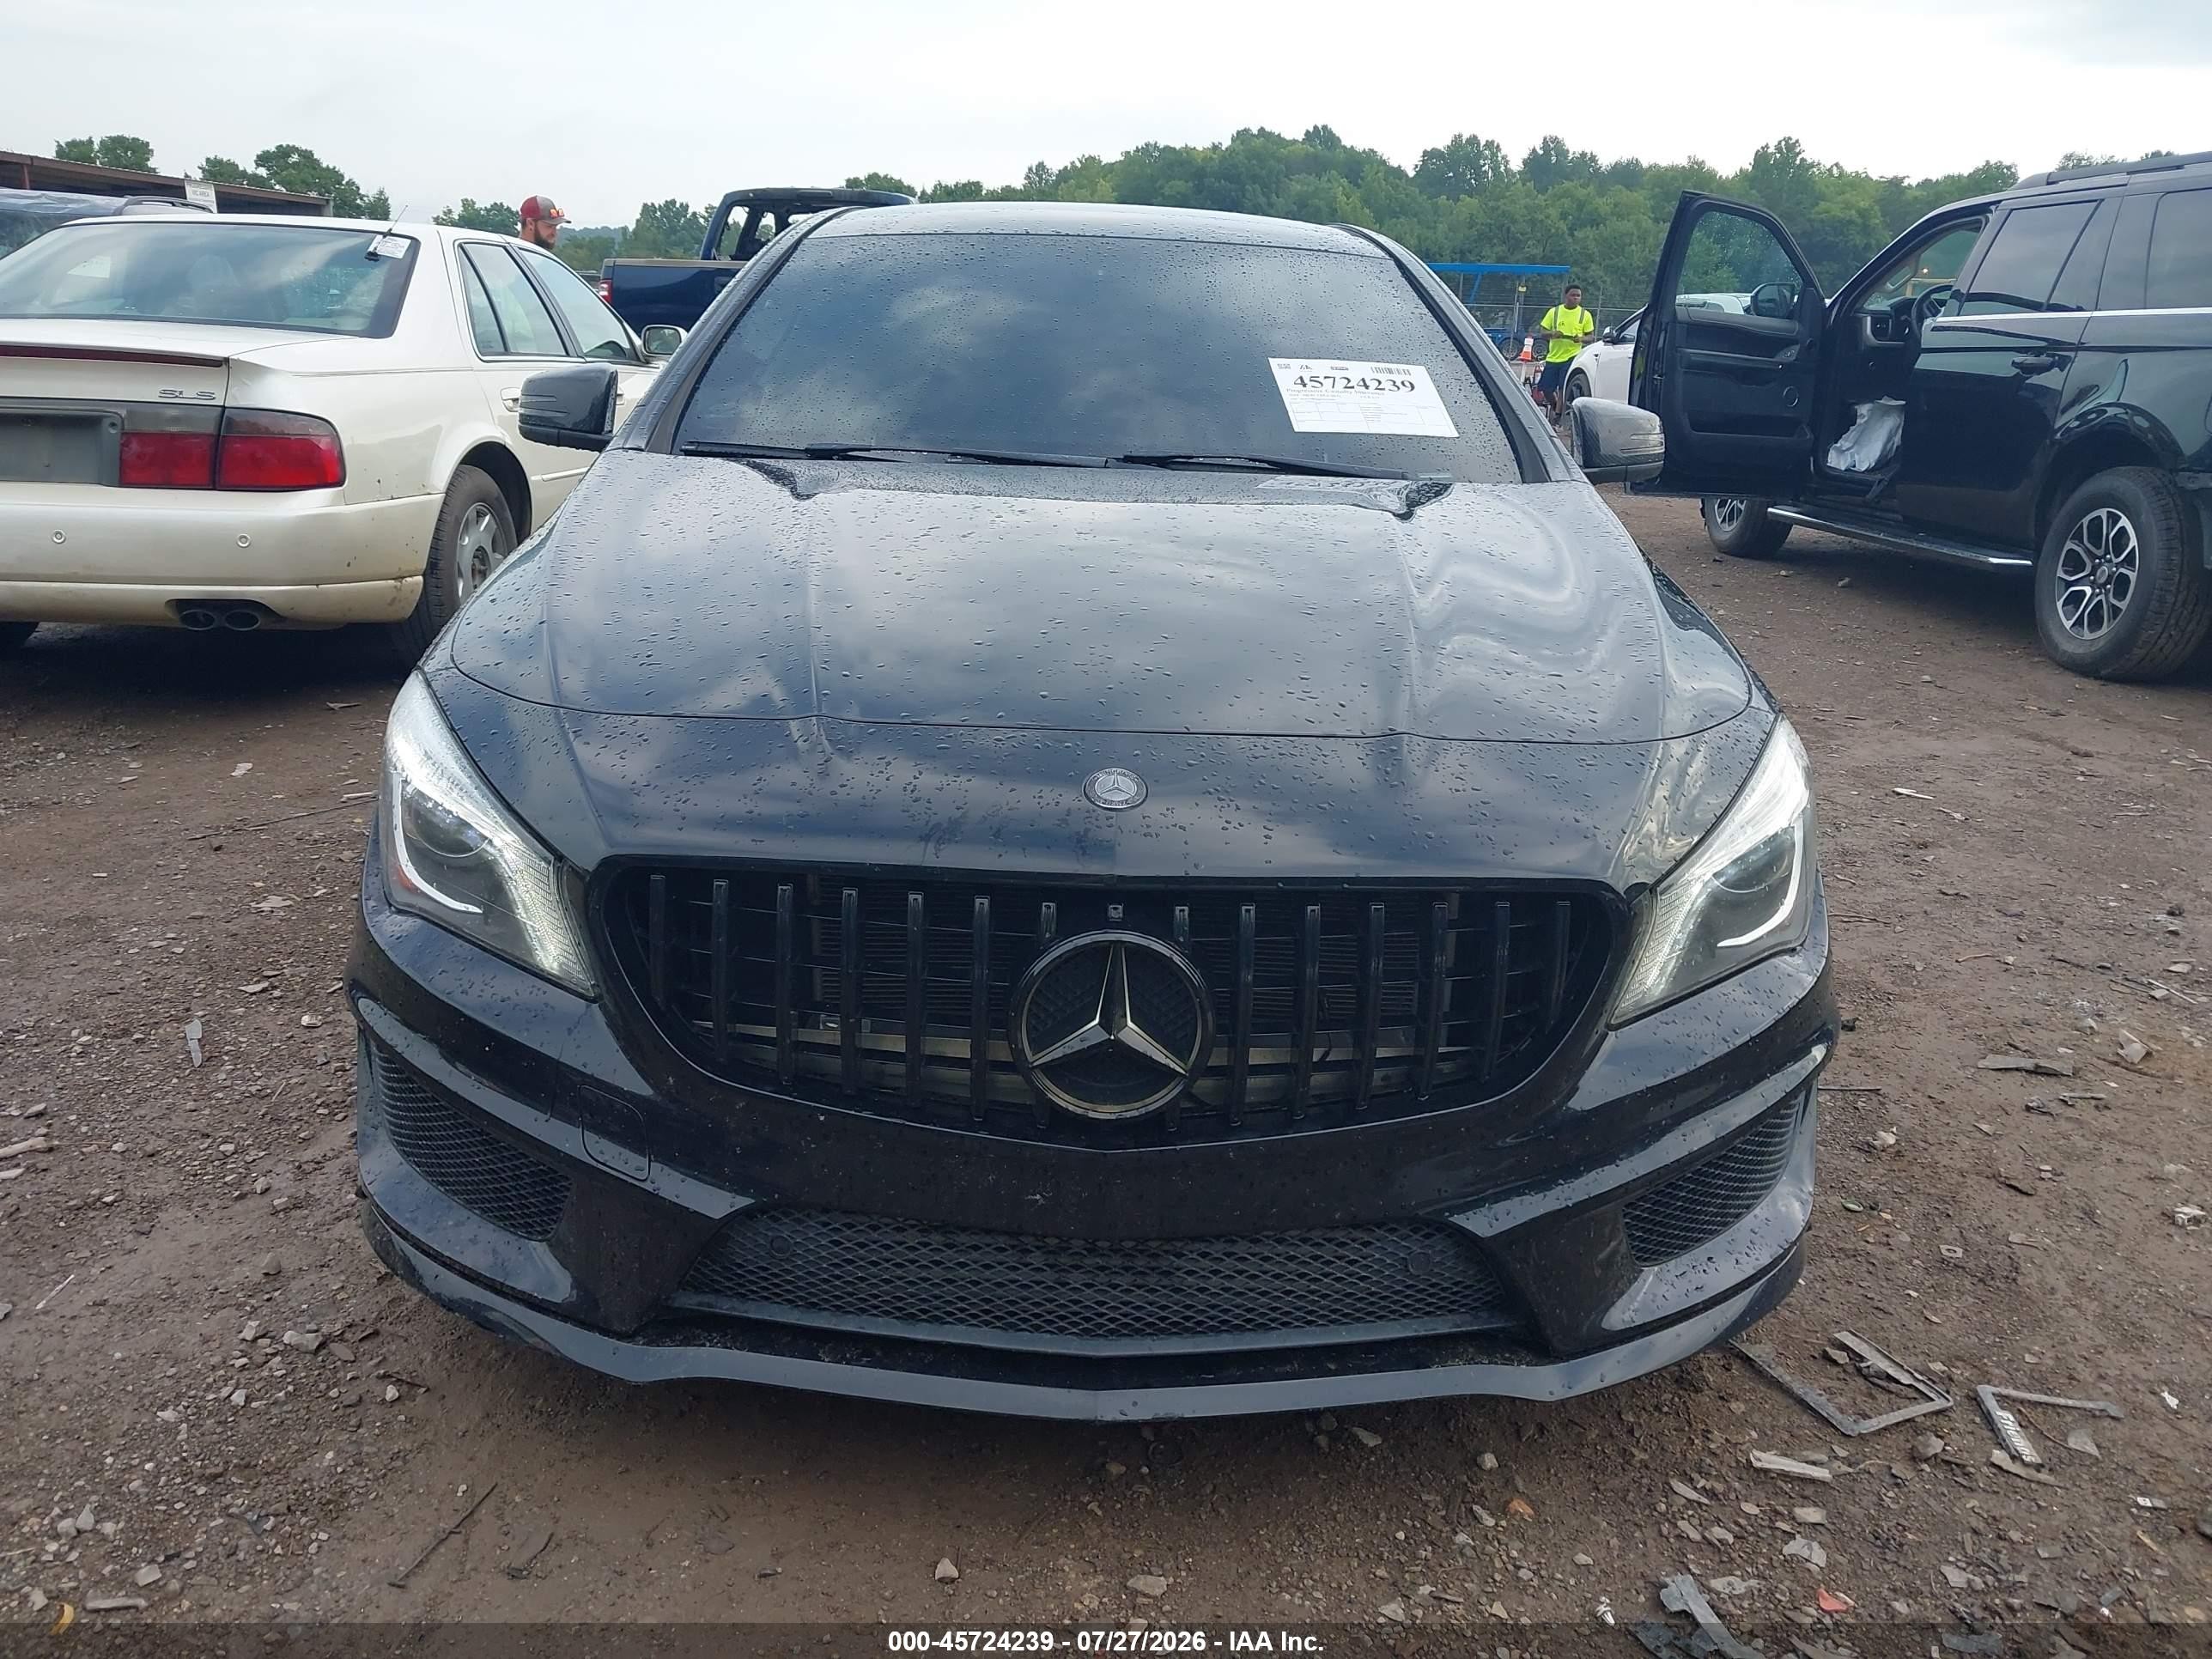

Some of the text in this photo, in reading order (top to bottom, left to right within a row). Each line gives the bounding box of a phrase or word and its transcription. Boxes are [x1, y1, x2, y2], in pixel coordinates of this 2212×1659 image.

[1293, 375, 1415, 392] 45724239
[158, 389, 216, 400] SLS
[1995, 1411, 2036, 1463] Friends
